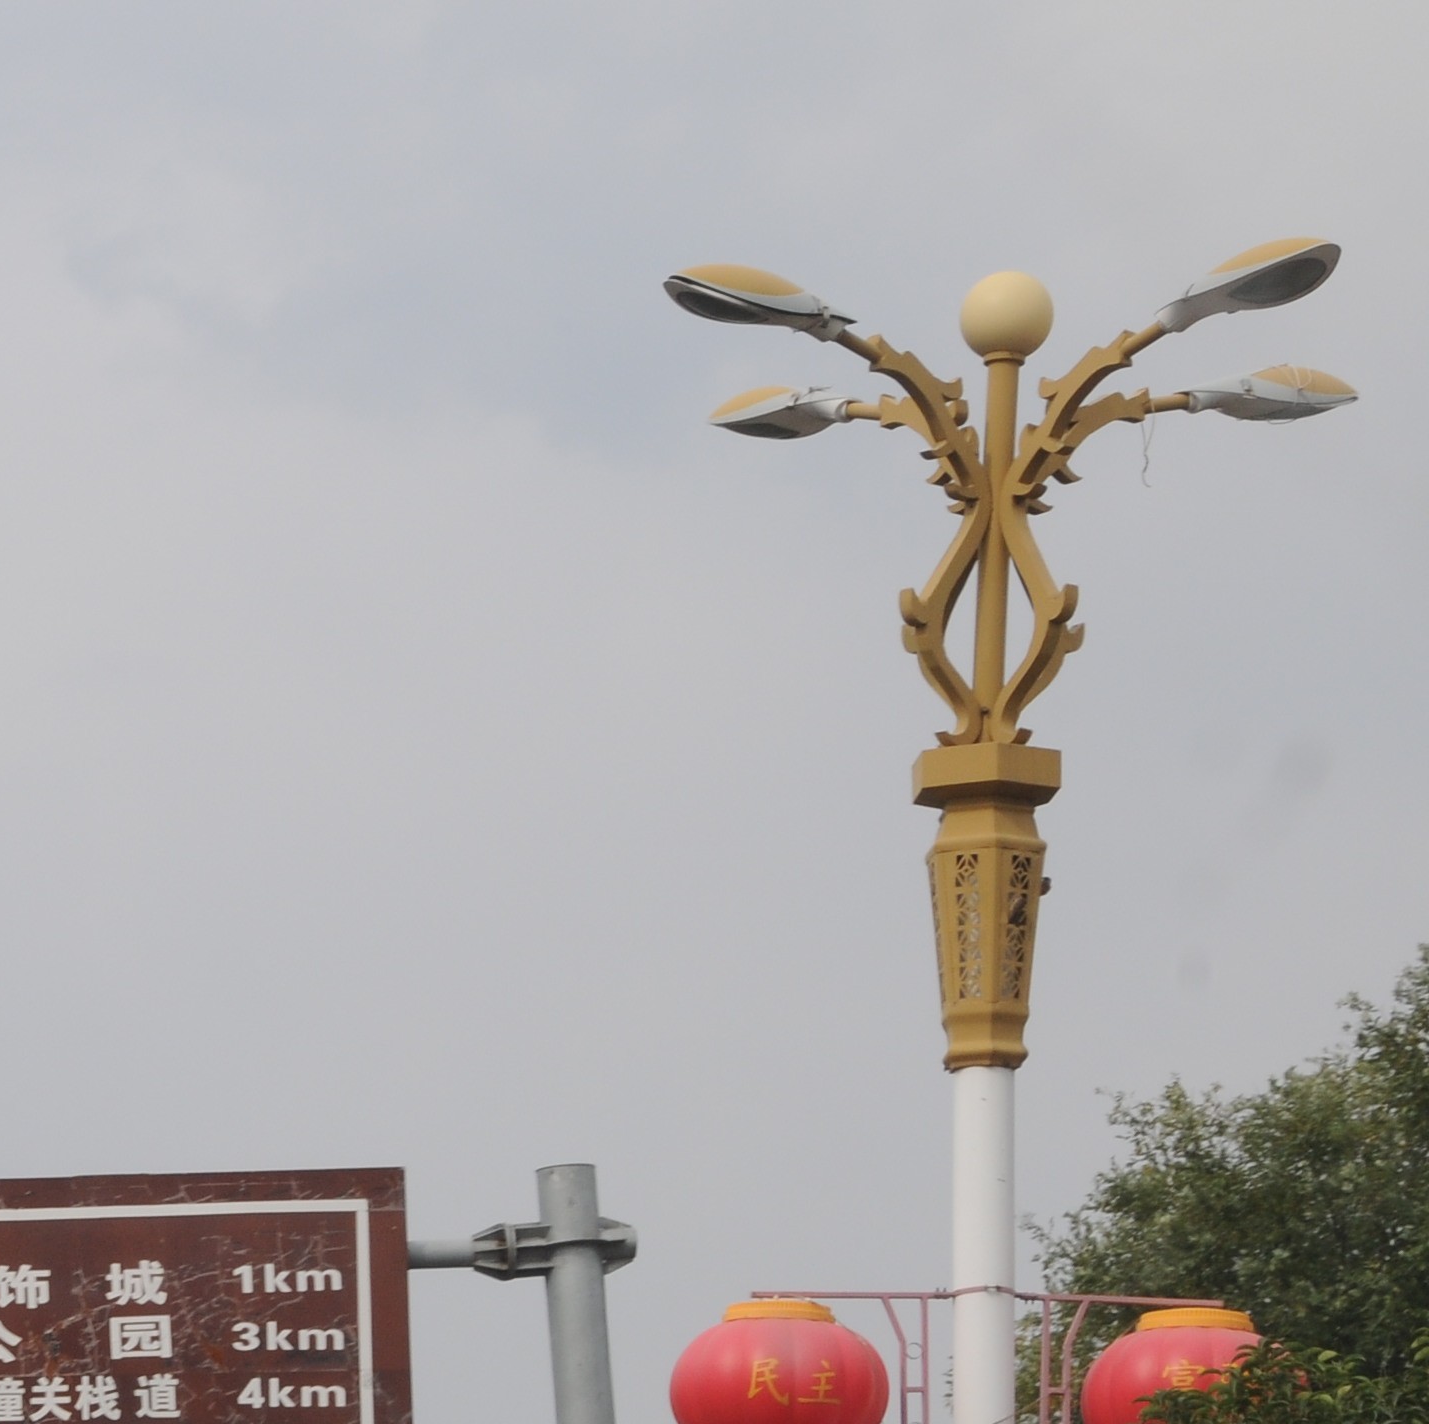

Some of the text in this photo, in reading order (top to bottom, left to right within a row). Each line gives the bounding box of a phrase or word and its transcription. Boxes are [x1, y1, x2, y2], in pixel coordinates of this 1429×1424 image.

[233, 1264, 342, 1294] 1km
[232, 1321, 344, 1351] 3km
[237, 1378, 346, 1409] 4km
[747, 1358, 842, 1404] 民主
